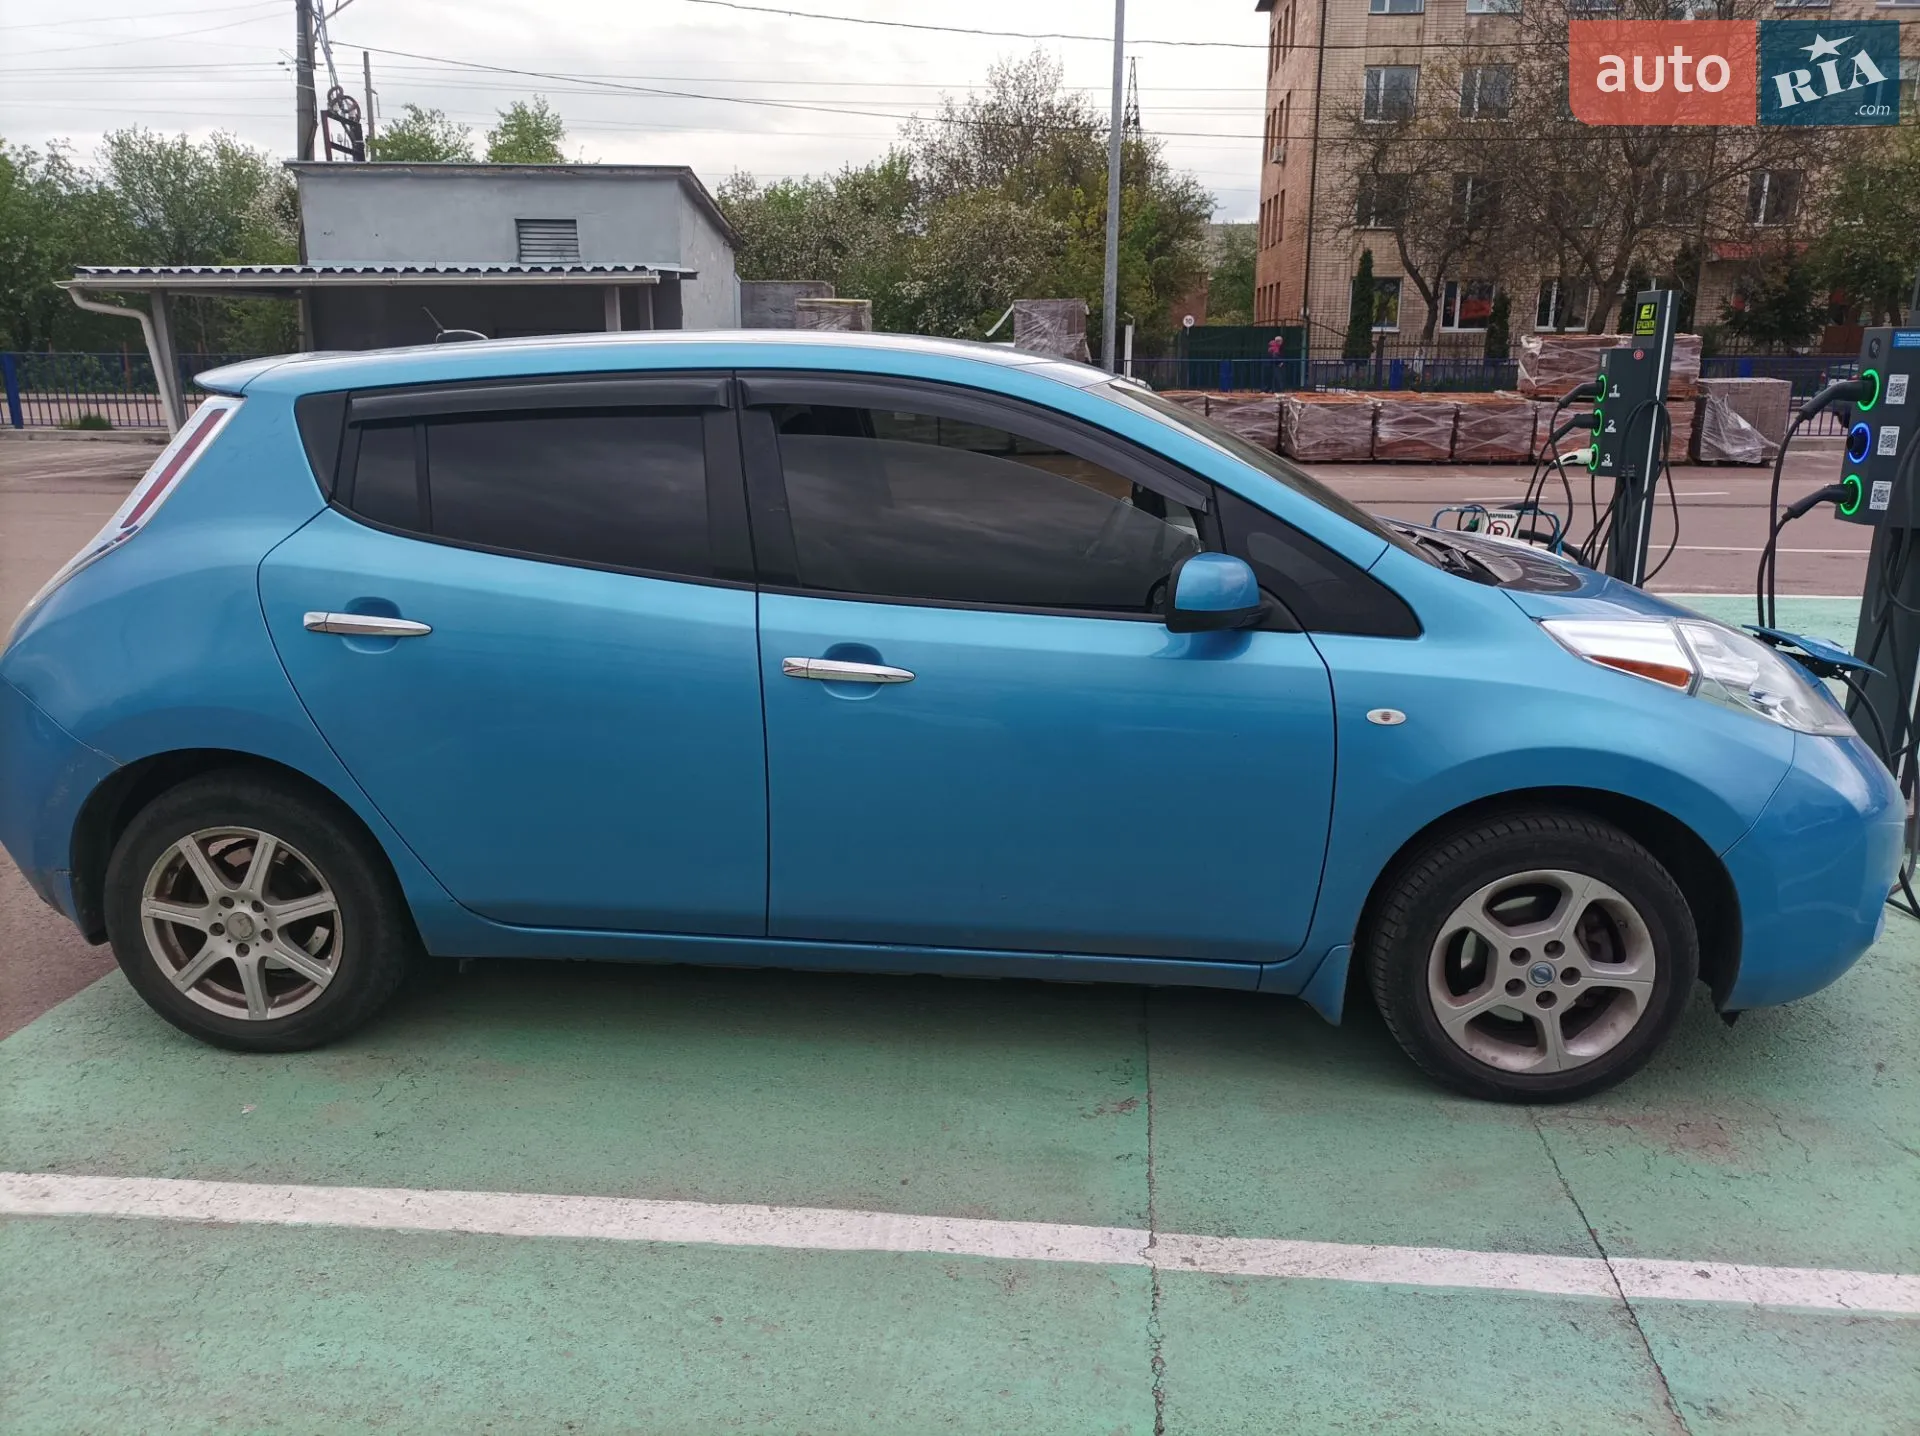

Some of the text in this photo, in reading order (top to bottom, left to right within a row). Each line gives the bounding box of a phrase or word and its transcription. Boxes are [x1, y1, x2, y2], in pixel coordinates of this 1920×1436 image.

[1612, 384, 1618, 394] 1
[1608, 420, 1615, 429] 2
[1604, 453, 1611, 462] 3
